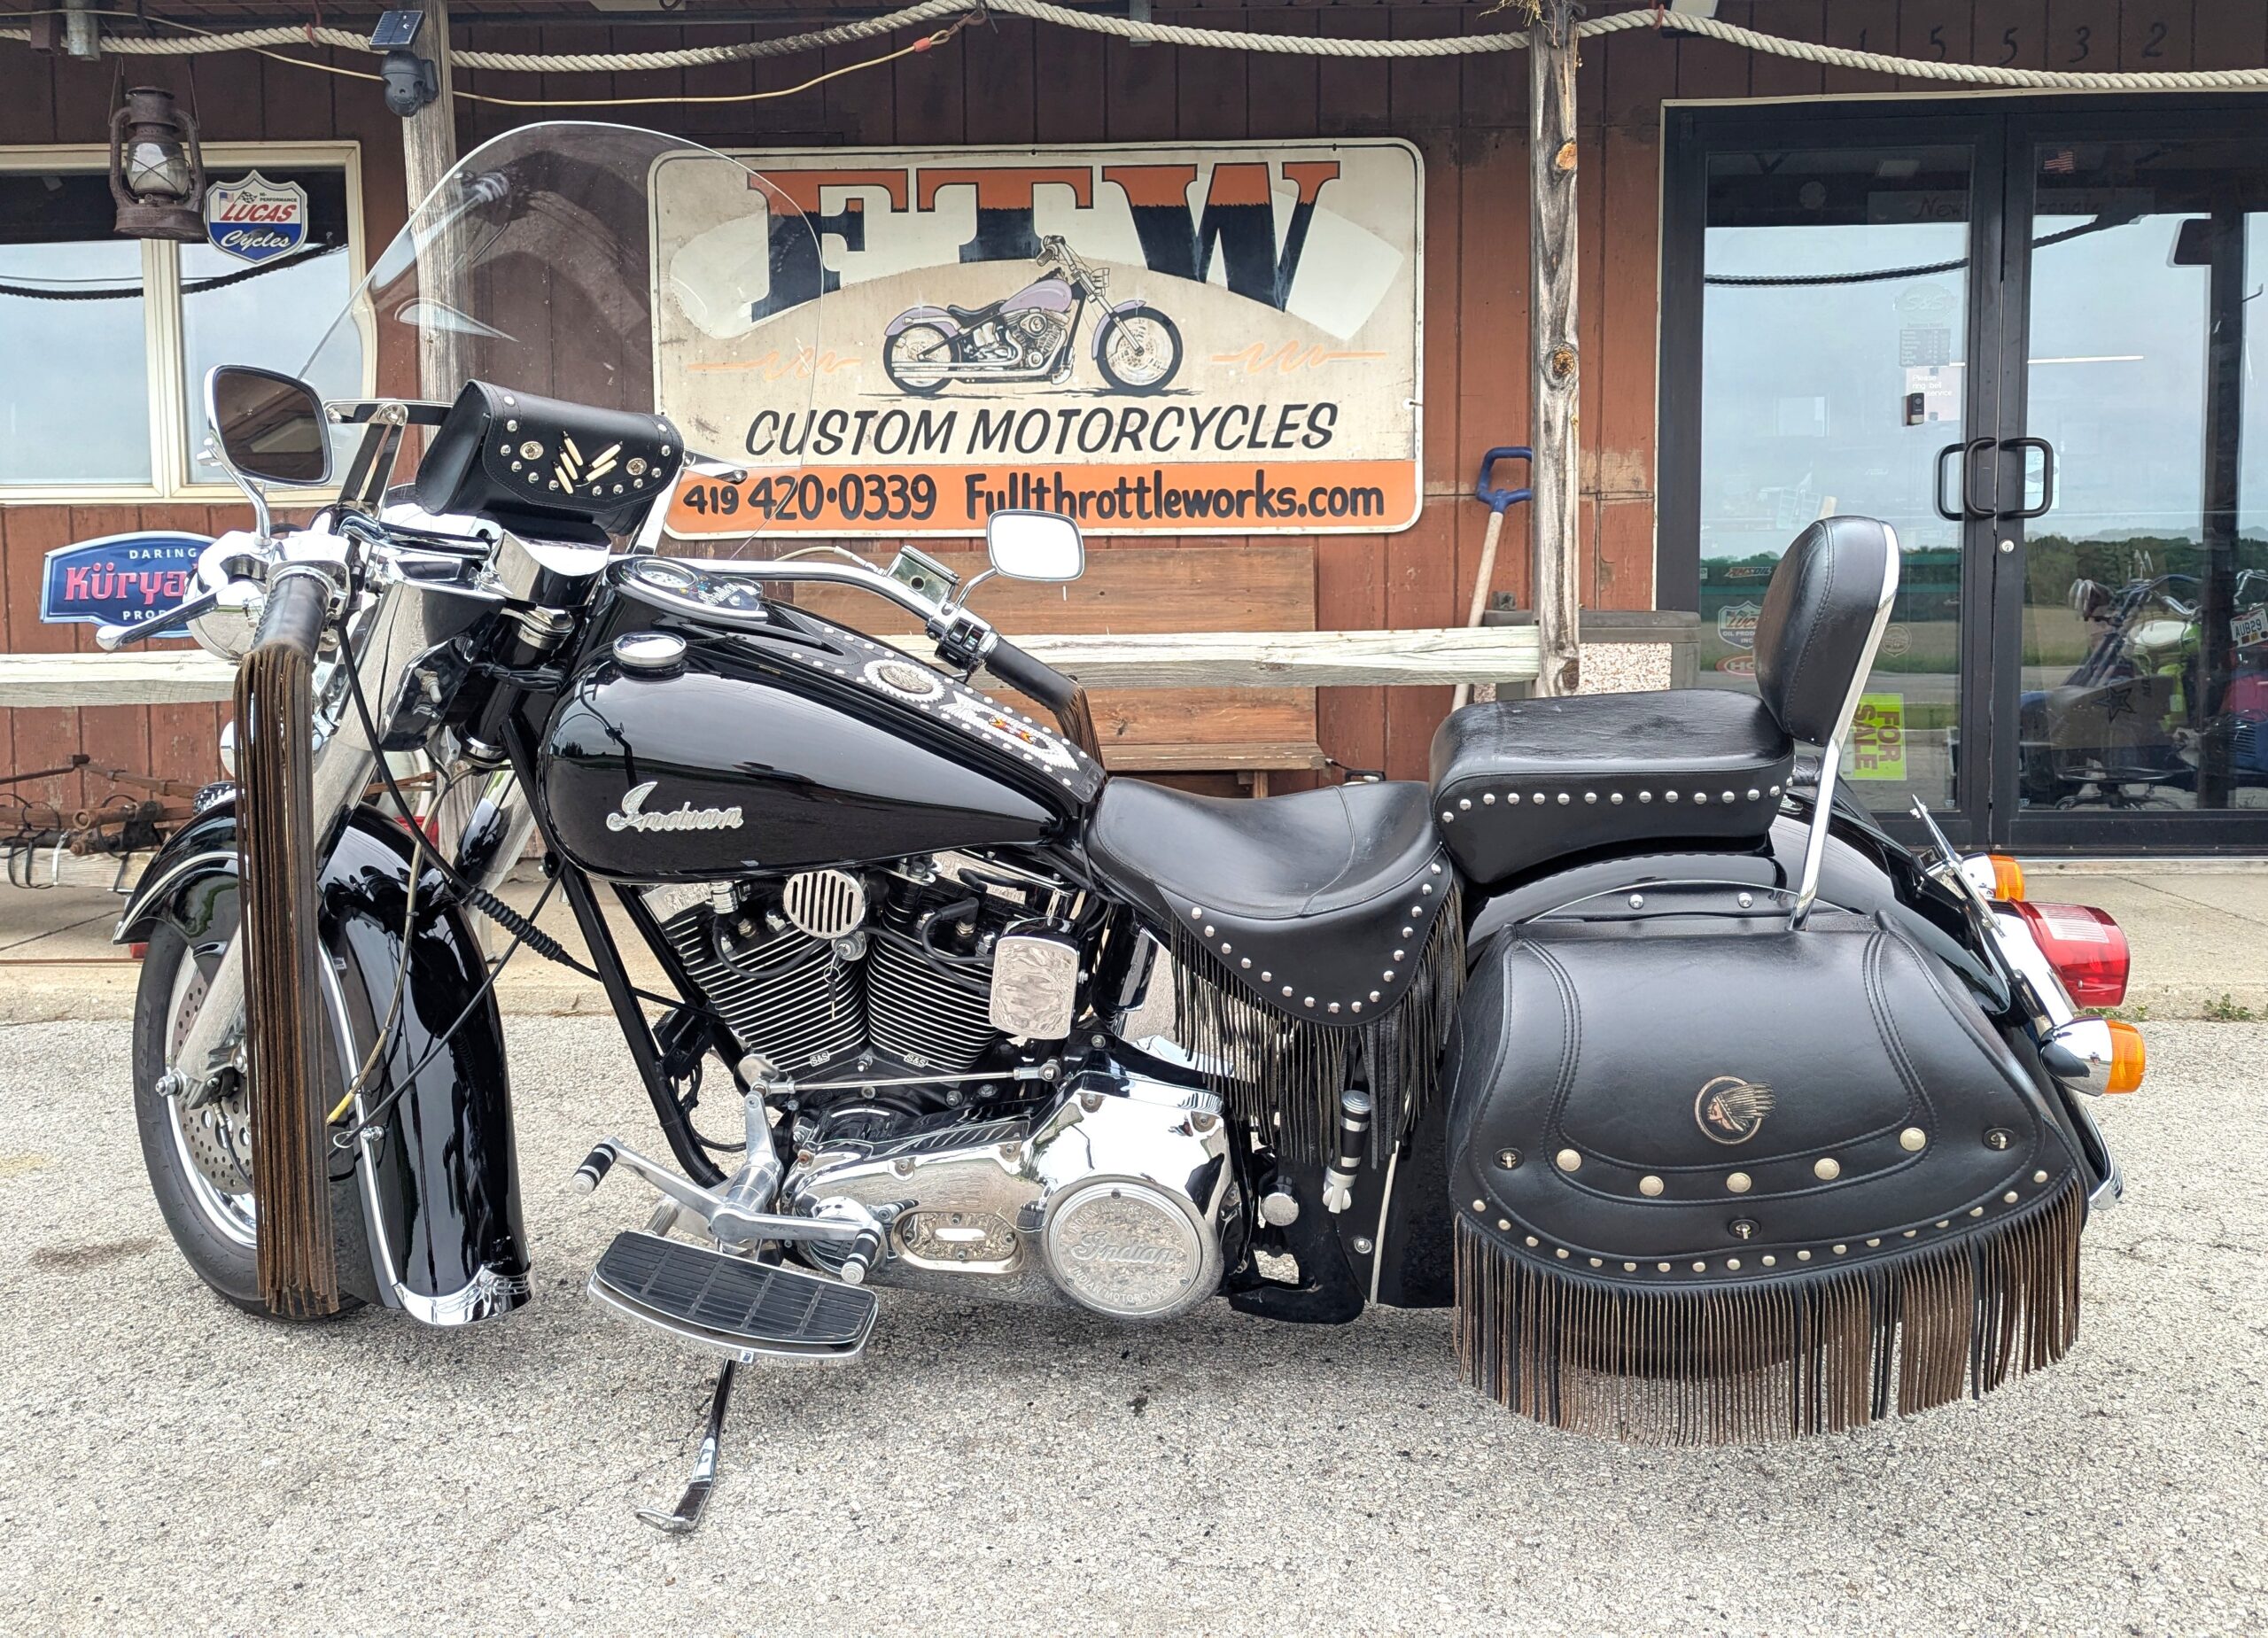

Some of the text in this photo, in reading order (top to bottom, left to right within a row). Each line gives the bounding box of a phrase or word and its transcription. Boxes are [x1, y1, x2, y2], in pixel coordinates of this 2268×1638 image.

[220, 205, 297, 221] LUCAS
[221, 230, 291, 252] Cycles
[746, 160, 1341, 321] FTW
[745, 402, 1338, 456] CUSTOM MOTORCYCLES
[683, 484, 738, 516] 419
[964, 469, 1384, 521] Fullthrottleworks.com
[128, 547, 197, 560] DARING
[64, 562, 191, 605] Kürya
[1853, 704, 1878, 770] SALE
[1877, 711, 1901, 761] FOR
[606, 781, 744, 833] Indian
[811, 1052, 830, 1067] S&S
[905, 1053, 928, 1067] S&S
[1069, 1207, 1099, 1234] INDIAN
[1071, 1230, 1176, 1265] Indian
[1071, 1266, 1102, 1295] INDIAN
